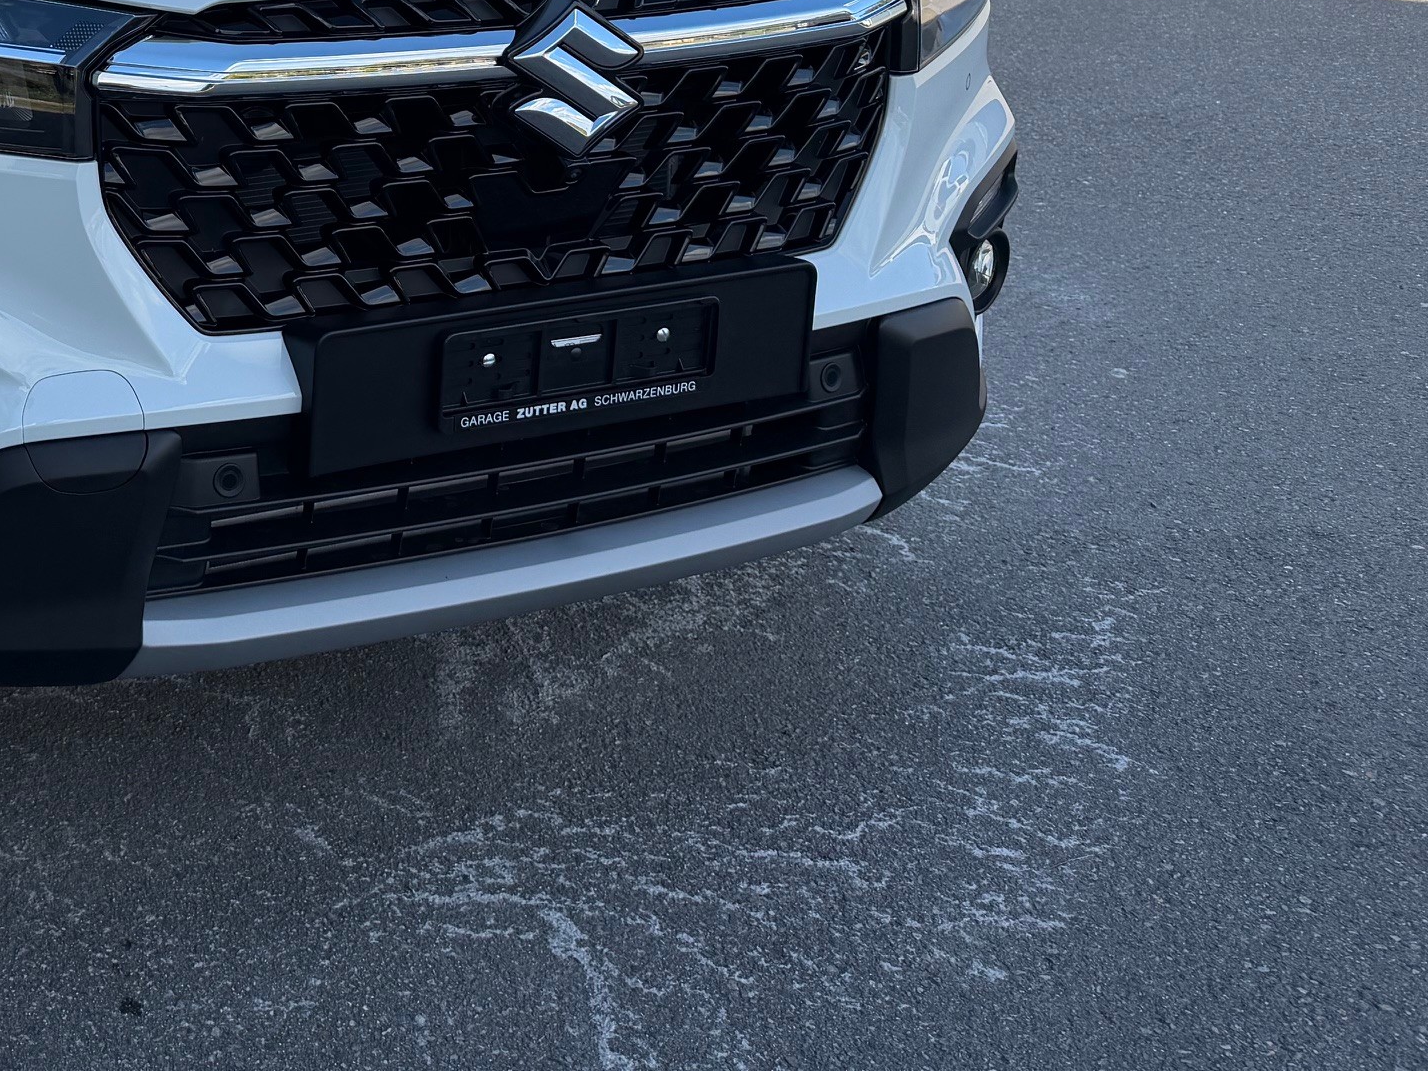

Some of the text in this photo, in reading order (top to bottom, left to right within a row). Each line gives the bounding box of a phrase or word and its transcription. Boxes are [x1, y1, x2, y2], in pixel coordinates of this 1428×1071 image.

[460, 381, 697, 428] GARAGE ZUTTER AG SCHWARZENBURG
